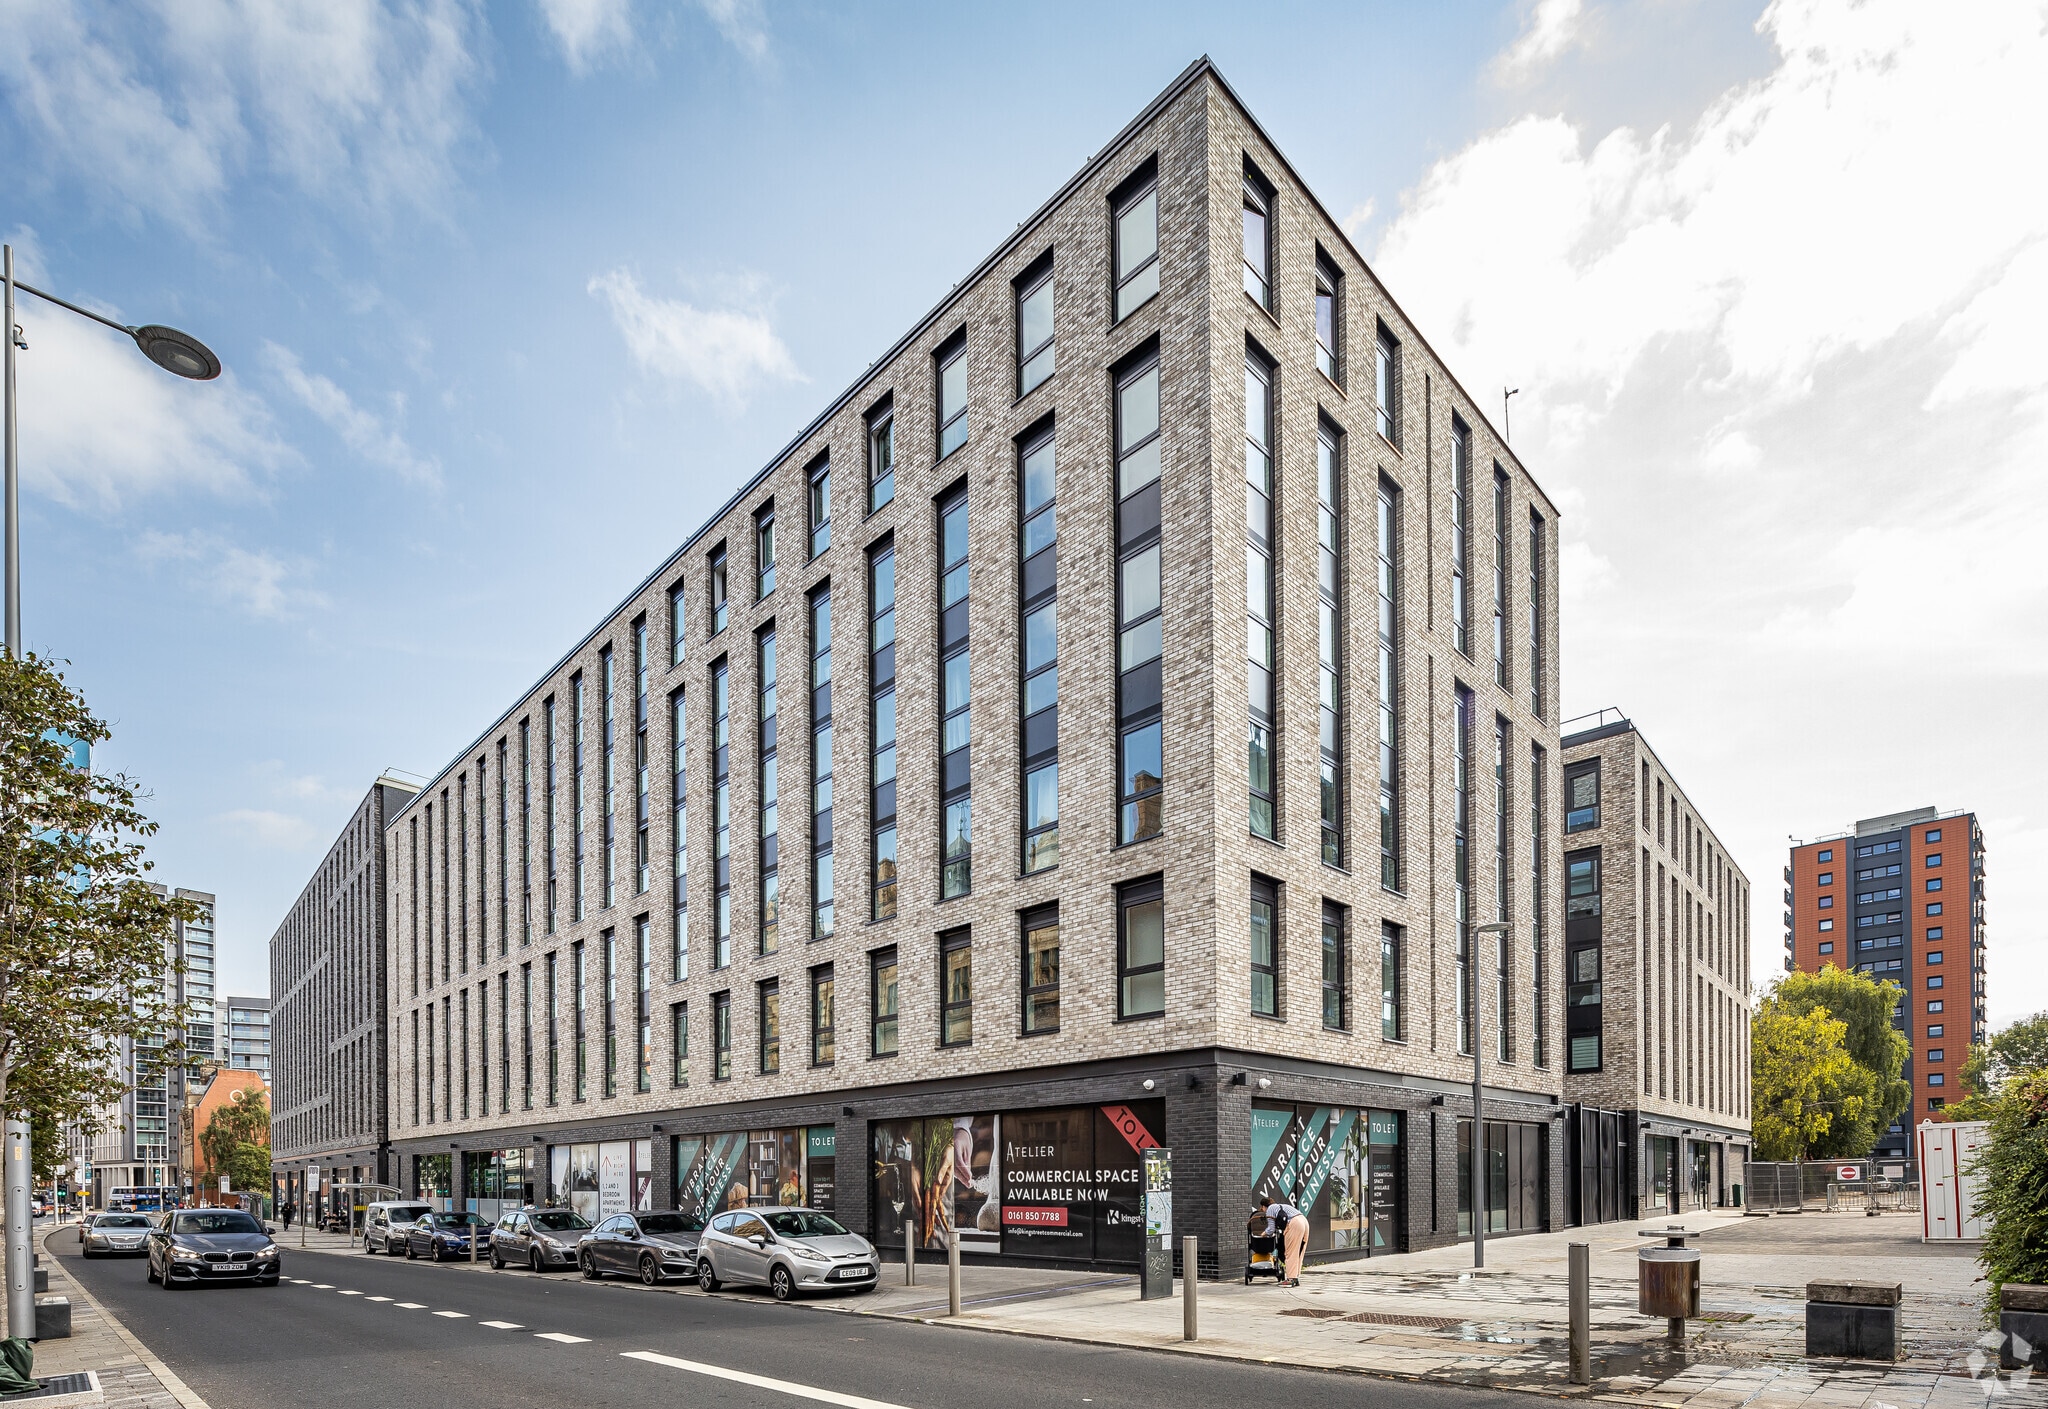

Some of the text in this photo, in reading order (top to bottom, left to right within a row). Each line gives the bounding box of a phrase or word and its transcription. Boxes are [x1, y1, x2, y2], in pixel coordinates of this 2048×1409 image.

[1117, 1108, 1136, 1135] TO
[1253, 1114, 1279, 1130] ATELIER
[1372, 1123, 1395, 1134] TO LET
[811, 1136, 835, 1146] TO LET
[1006, 1141, 1055, 1163] ATELIER
[1298, 1136, 1326, 1188] YOUR
[705, 1157, 725, 1194] YOUR
[1007, 1169, 1139, 1183] COMMERCIAL SPACE
[1301, 1145, 1335, 1212] SINESS
[1007, 1188, 1109, 1202] AVAILABLE NOW
[1008, 1211, 1060, 1221] 0161 850 7788
